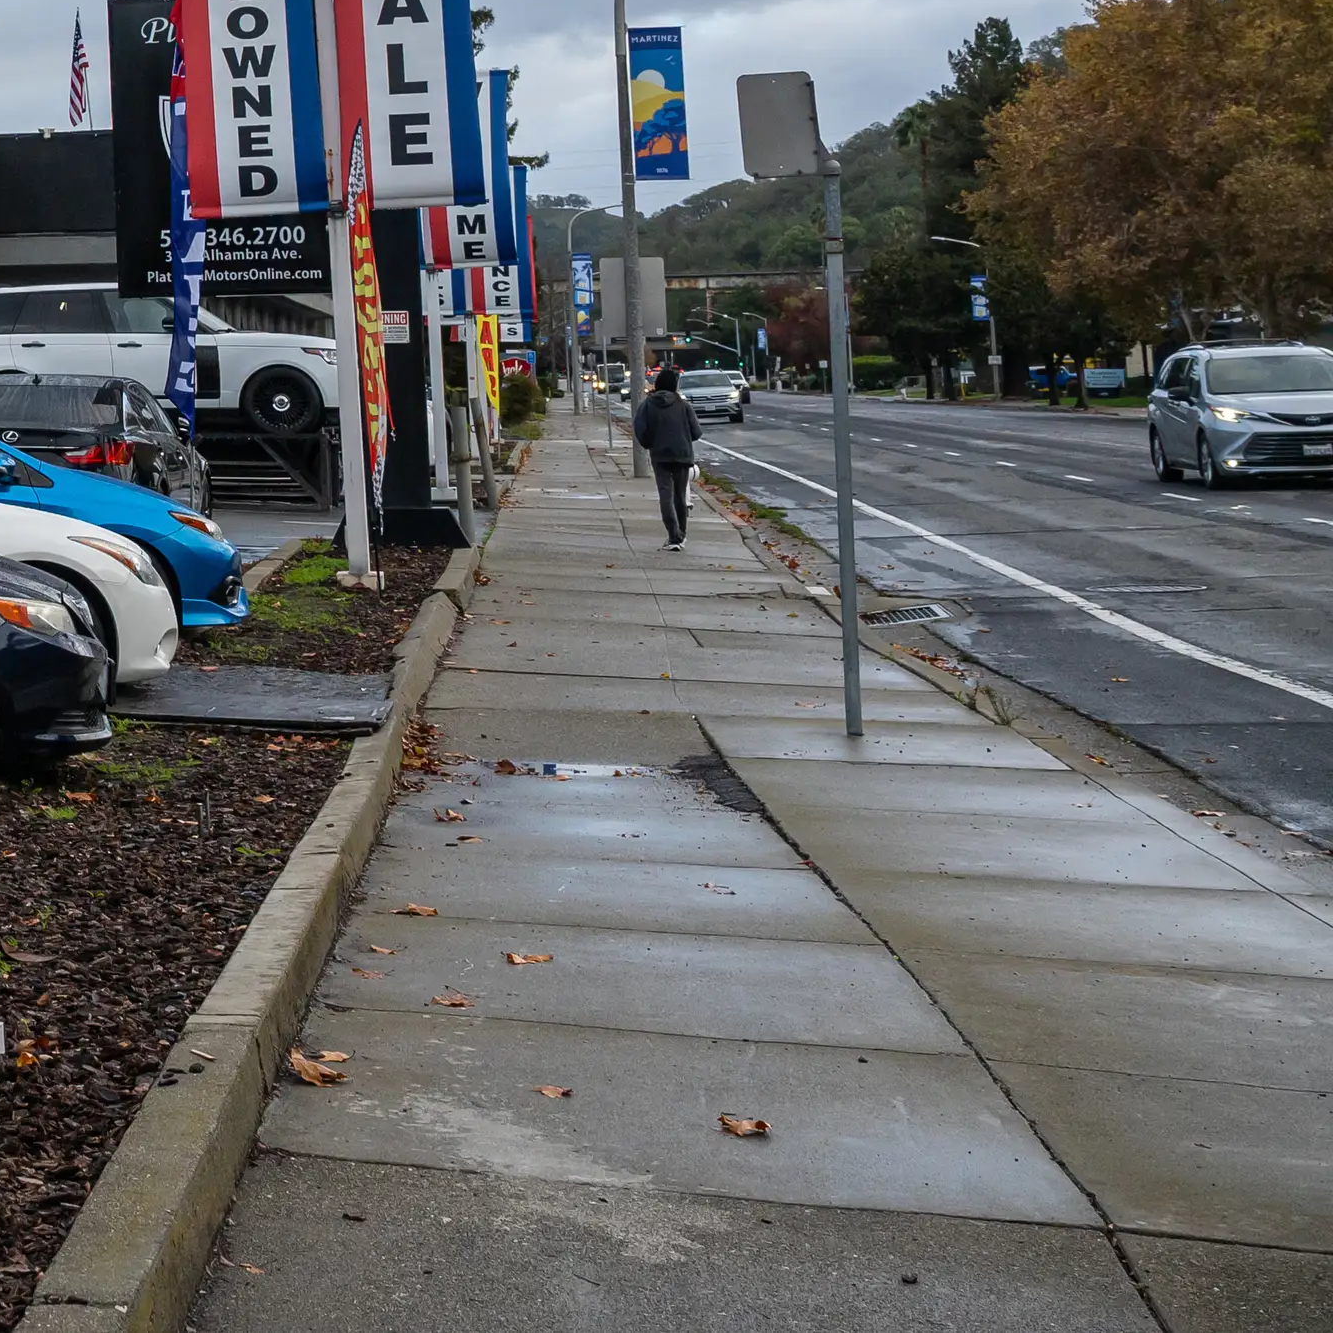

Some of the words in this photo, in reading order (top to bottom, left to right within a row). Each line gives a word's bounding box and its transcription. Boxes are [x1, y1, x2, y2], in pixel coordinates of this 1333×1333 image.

[631, 34, 679, 44] MARTINEZ
[203, 248, 268, 262] Alhambra
[272, 247, 302, 260] Ave.
[382, 313, 407, 324] NING
